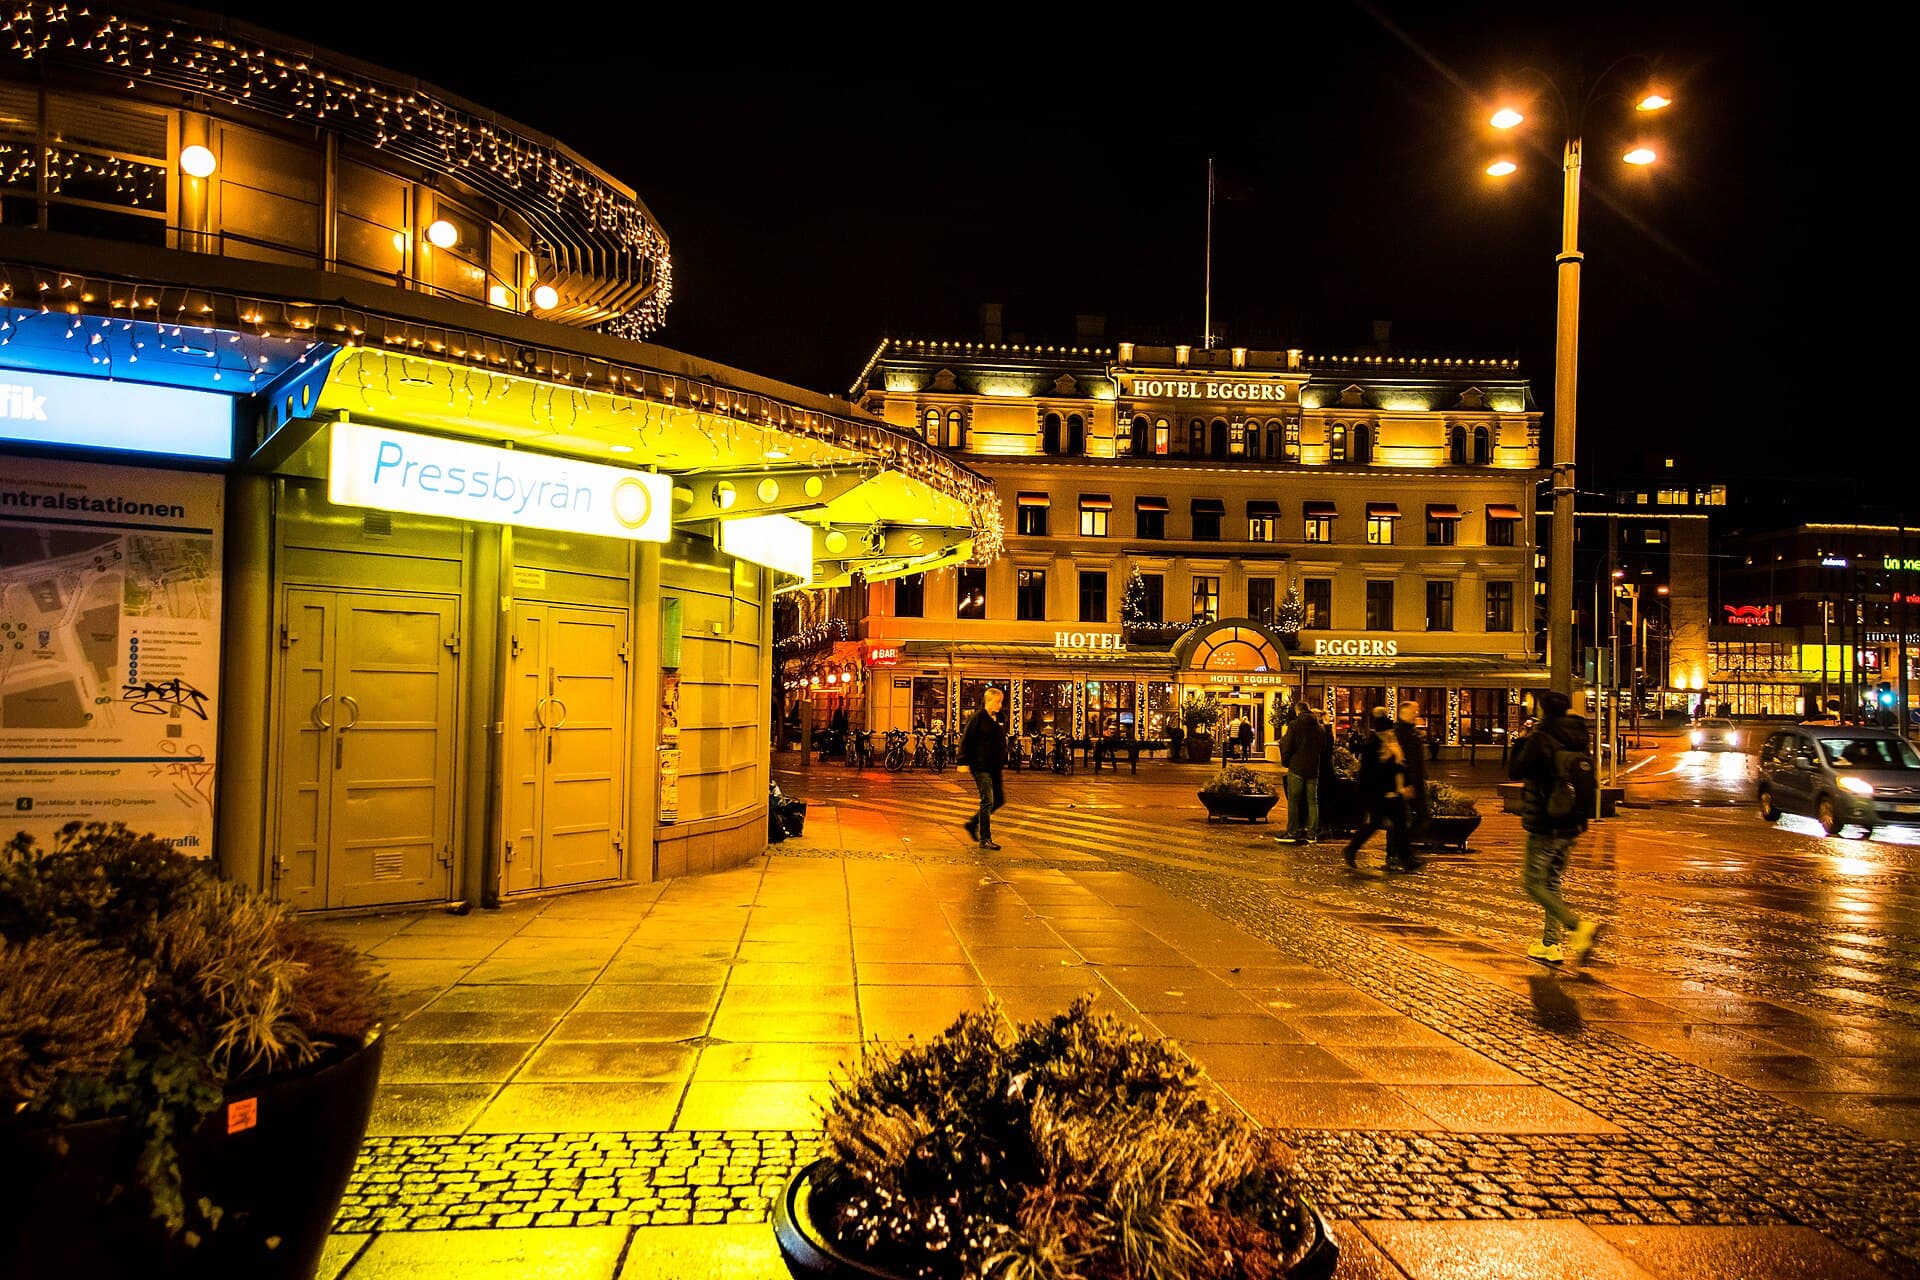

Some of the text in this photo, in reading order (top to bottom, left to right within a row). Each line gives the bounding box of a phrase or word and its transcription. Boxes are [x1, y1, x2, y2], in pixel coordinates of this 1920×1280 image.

[1133, 381, 1286, 400] HOTEL EGGERS
[374, 441, 592, 514] Pressbyrån
[1054, 632, 1126, 651] HOTEL
[1315, 639, 1397, 656] EGGERS
[879, 649, 895, 658] BAR
[1243, 676, 1282, 684] EGGERS
